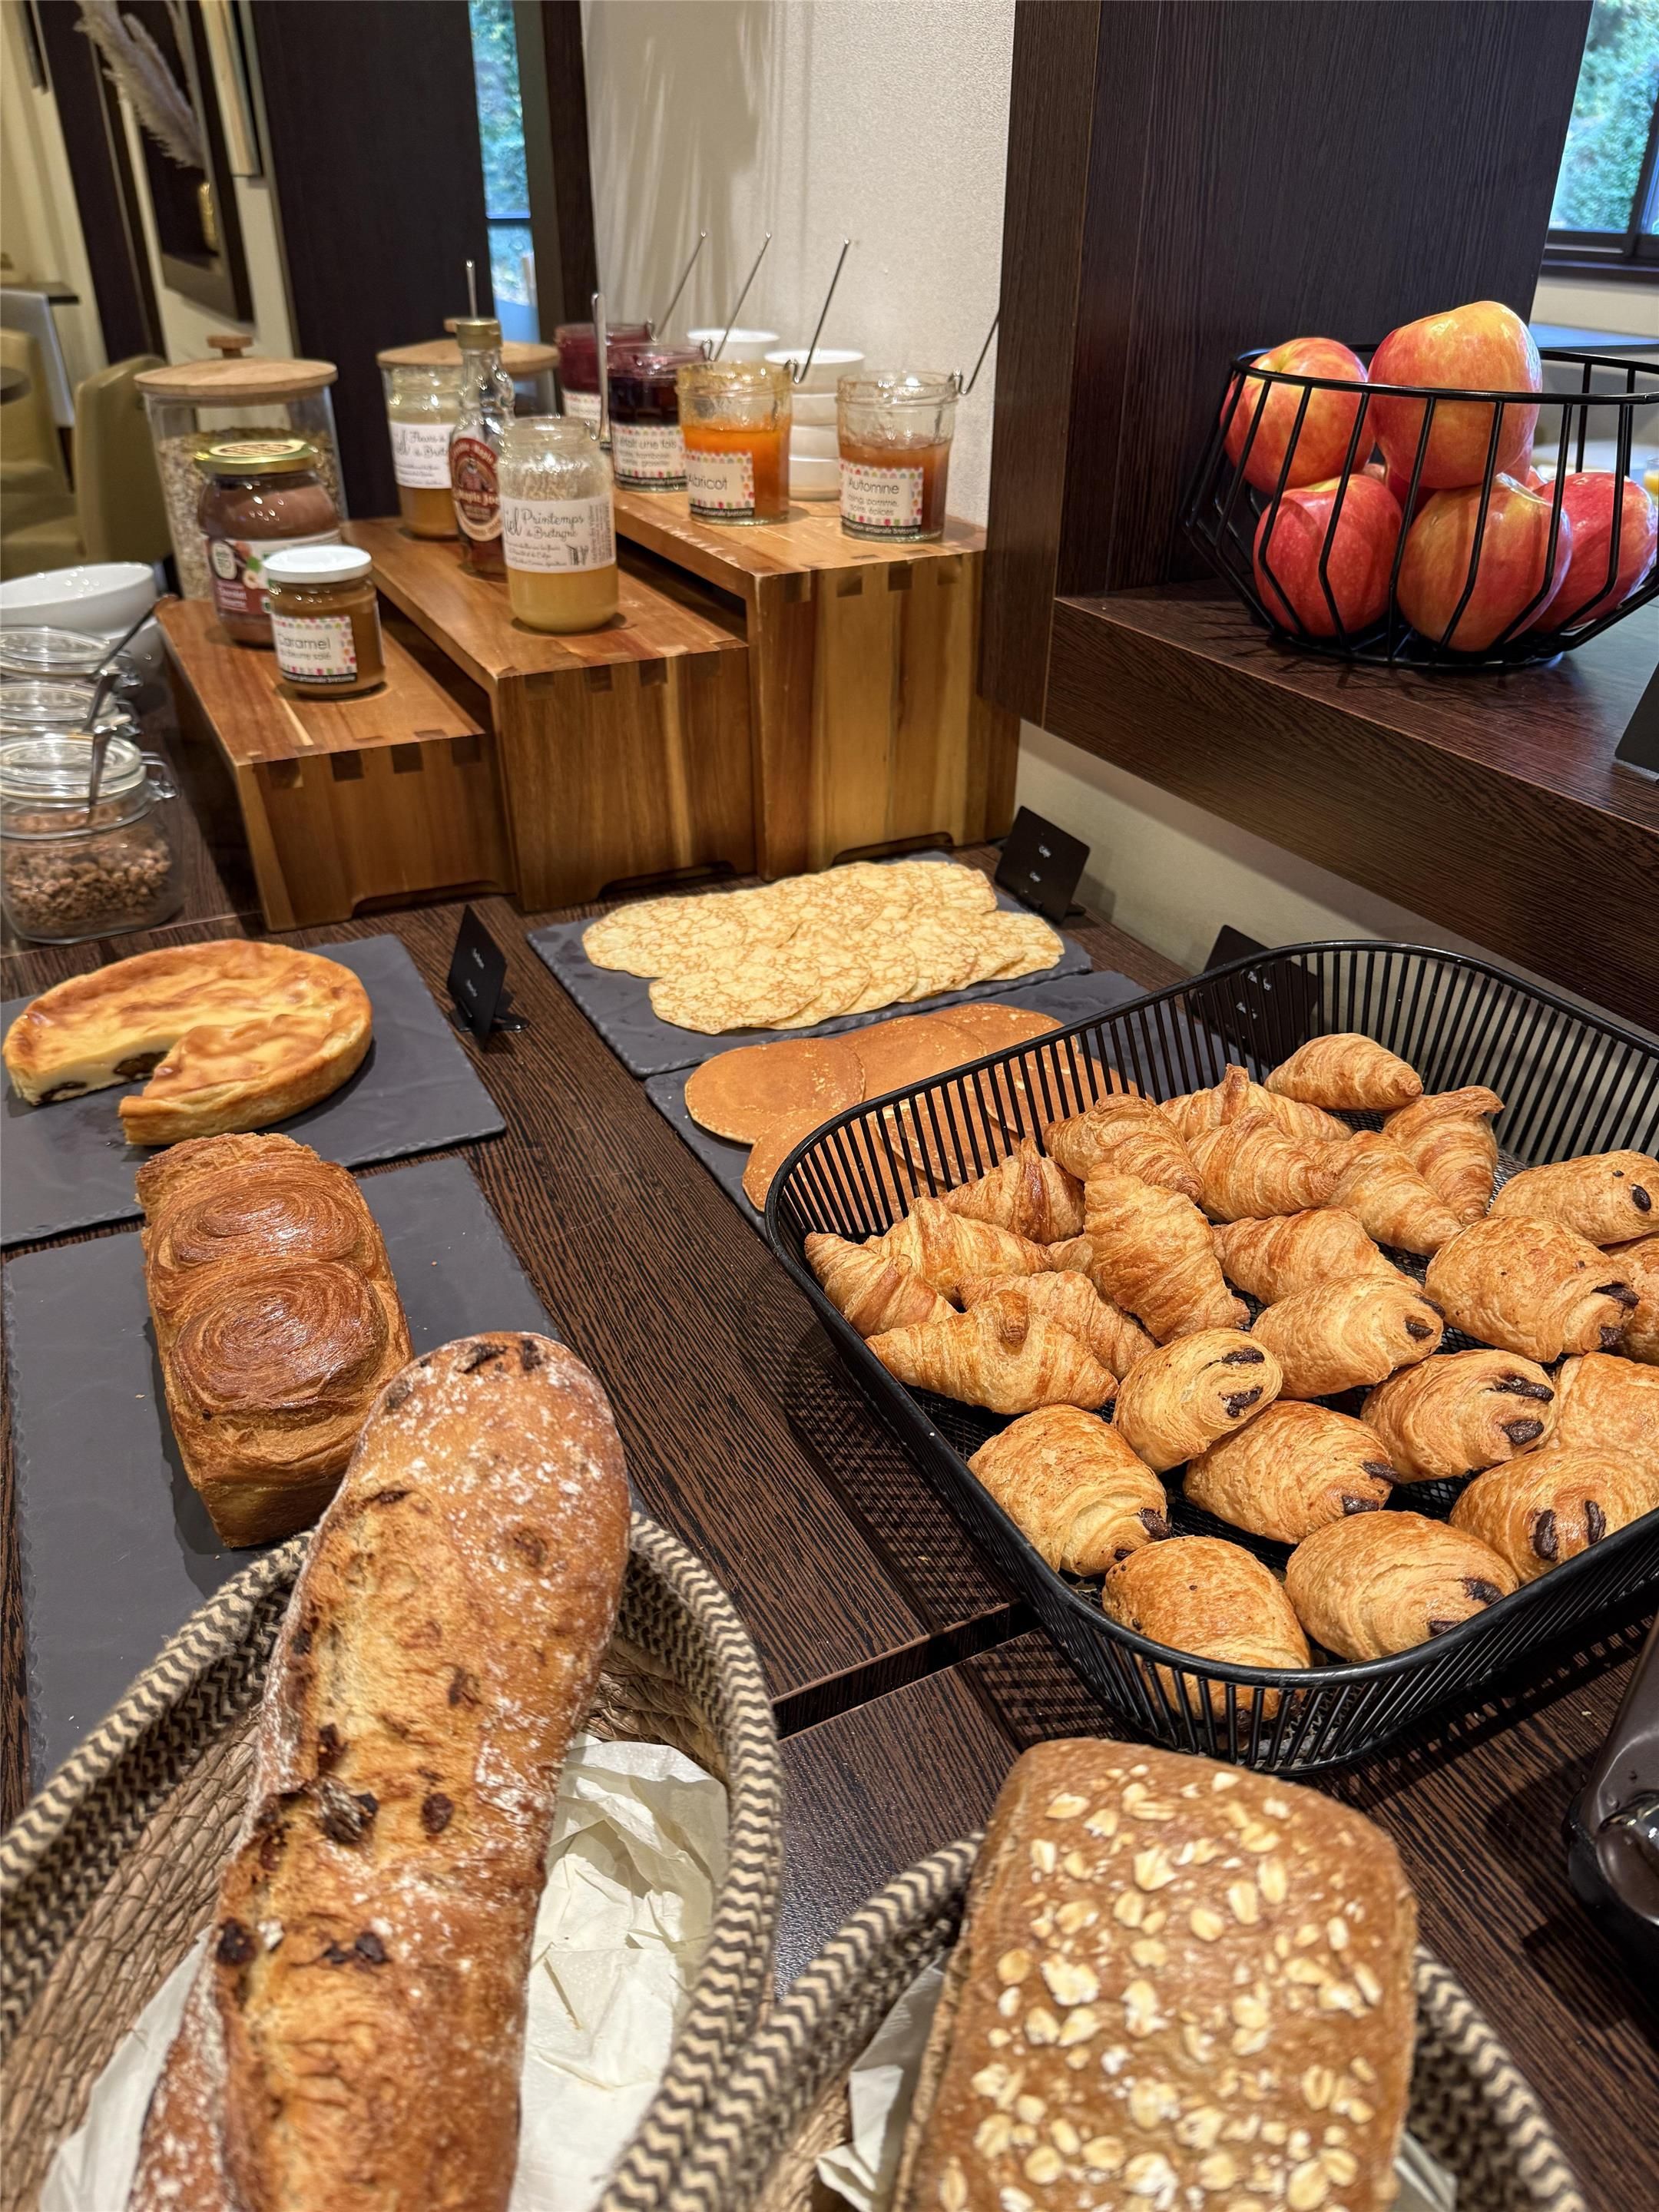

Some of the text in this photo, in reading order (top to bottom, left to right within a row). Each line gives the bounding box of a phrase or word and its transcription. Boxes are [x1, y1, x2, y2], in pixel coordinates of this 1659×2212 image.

[848, 478, 900, 495] Automne
[521, 508, 585, 530] Printemps
[533, 525, 578, 542] Bretagne
[276, 633, 332, 650] Caramel
